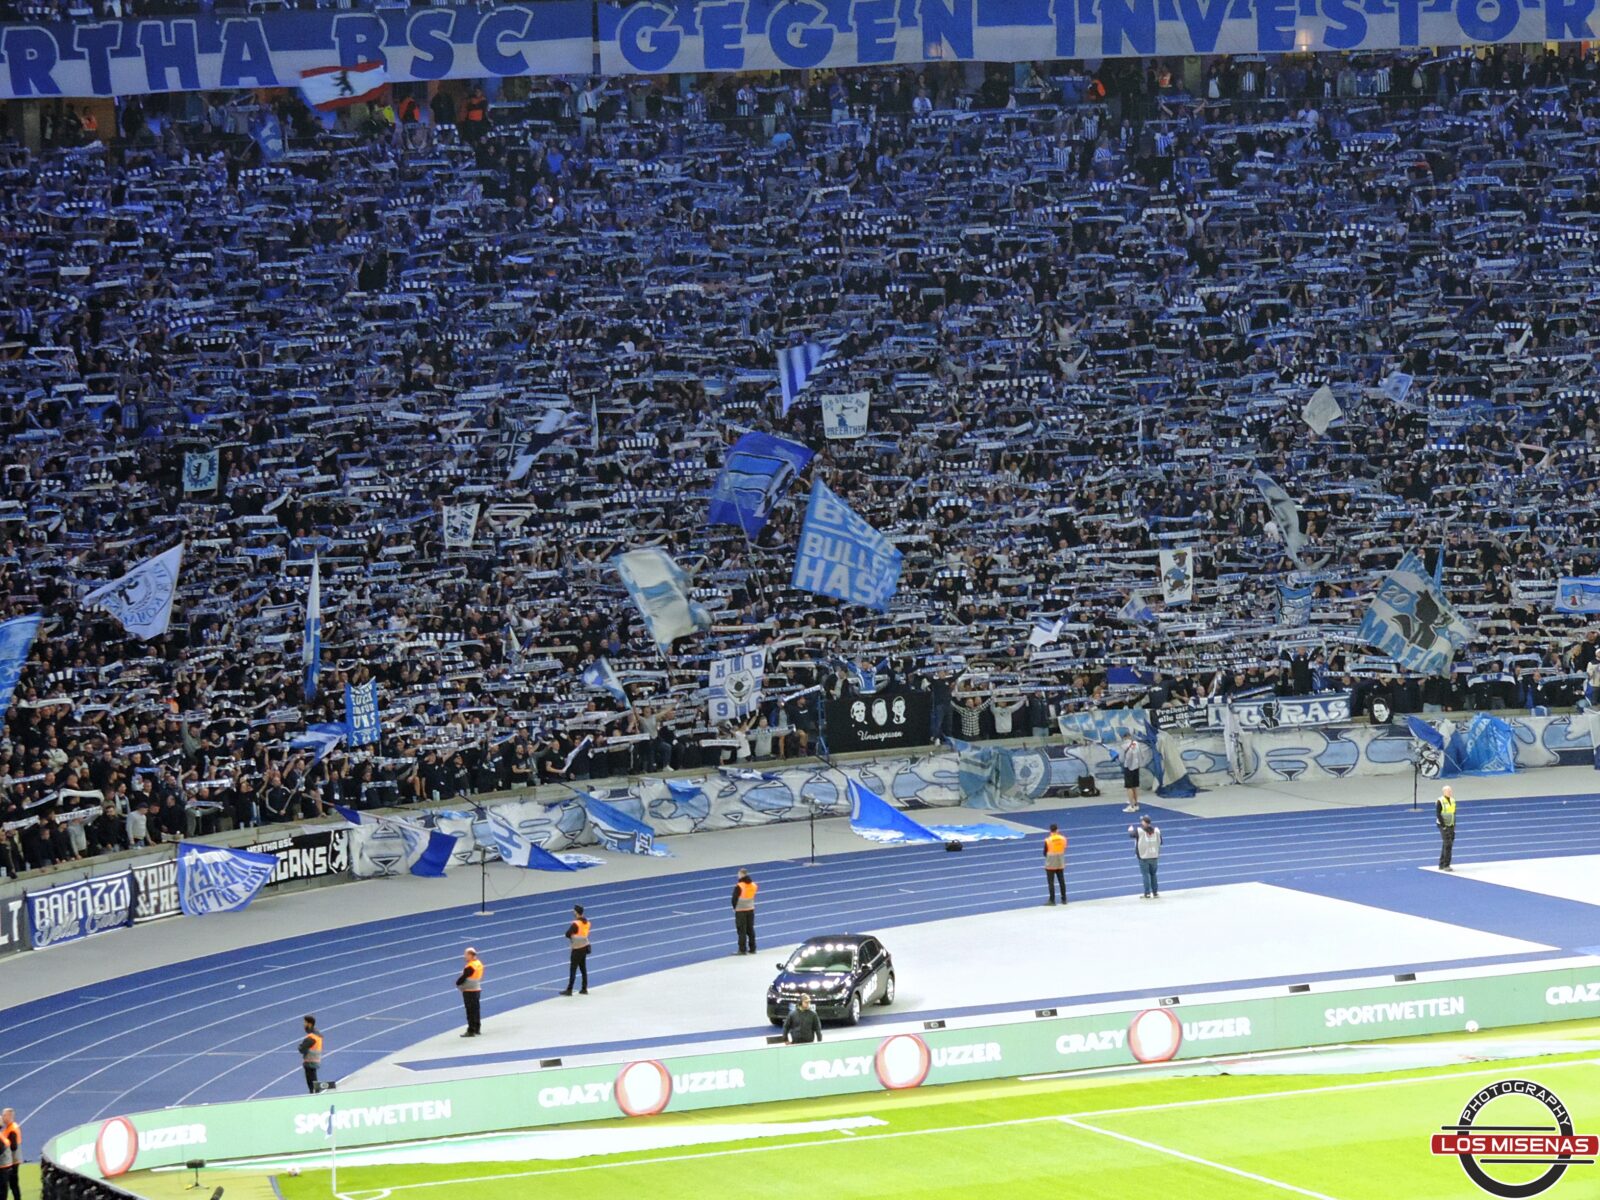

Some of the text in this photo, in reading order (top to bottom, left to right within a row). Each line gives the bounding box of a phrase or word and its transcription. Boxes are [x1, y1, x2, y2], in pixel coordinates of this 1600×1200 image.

[331, 6, 534, 82] BSC
[615, 0, 974, 72] GEGEN
[1325, 996, 1465, 1028] SPORTWETTEN
[1056, 1029, 1126, 1055] CRAZY
[801, 1055, 873, 1081] CRAZY
[538, 1081, 613, 1108] CRAZY
[294, 1098, 453, 1136] SPORTWETTEN
